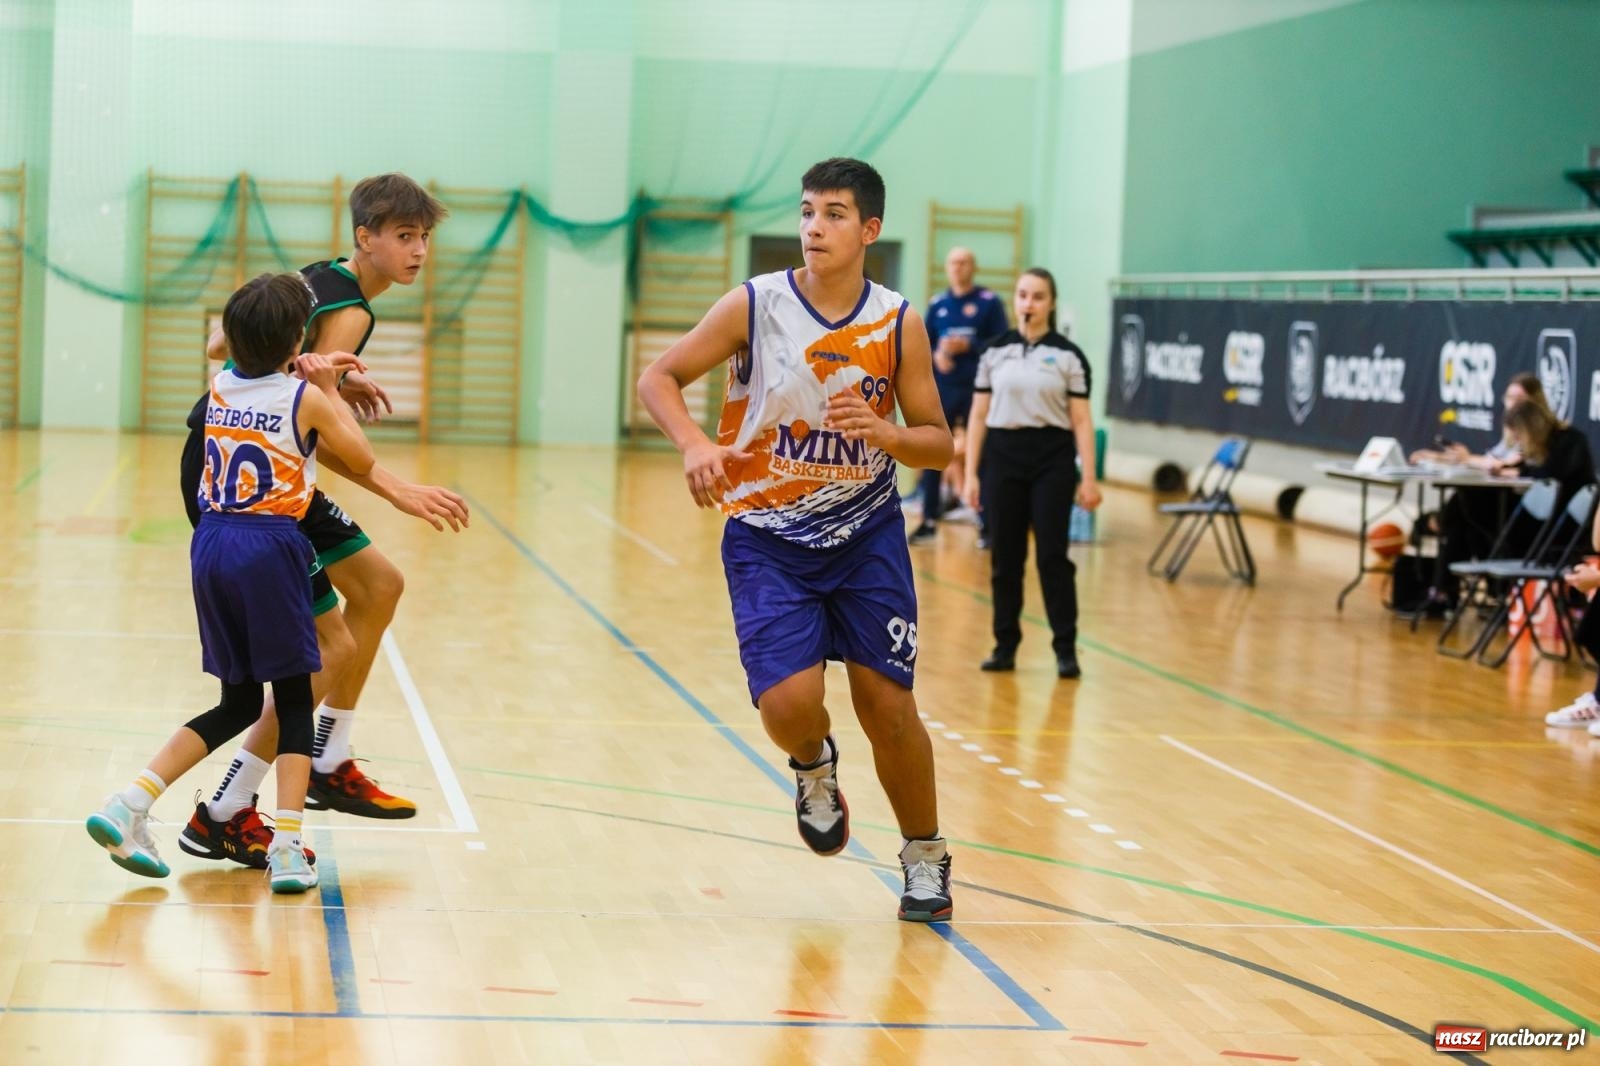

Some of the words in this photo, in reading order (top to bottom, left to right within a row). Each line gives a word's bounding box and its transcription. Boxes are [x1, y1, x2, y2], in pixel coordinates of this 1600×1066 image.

[860, 376, 889, 408] 99
[205, 406, 283, 433] ACIBÓRZ
[772, 456, 873, 481] BASKETBALL
[886, 616, 917, 661] 99
